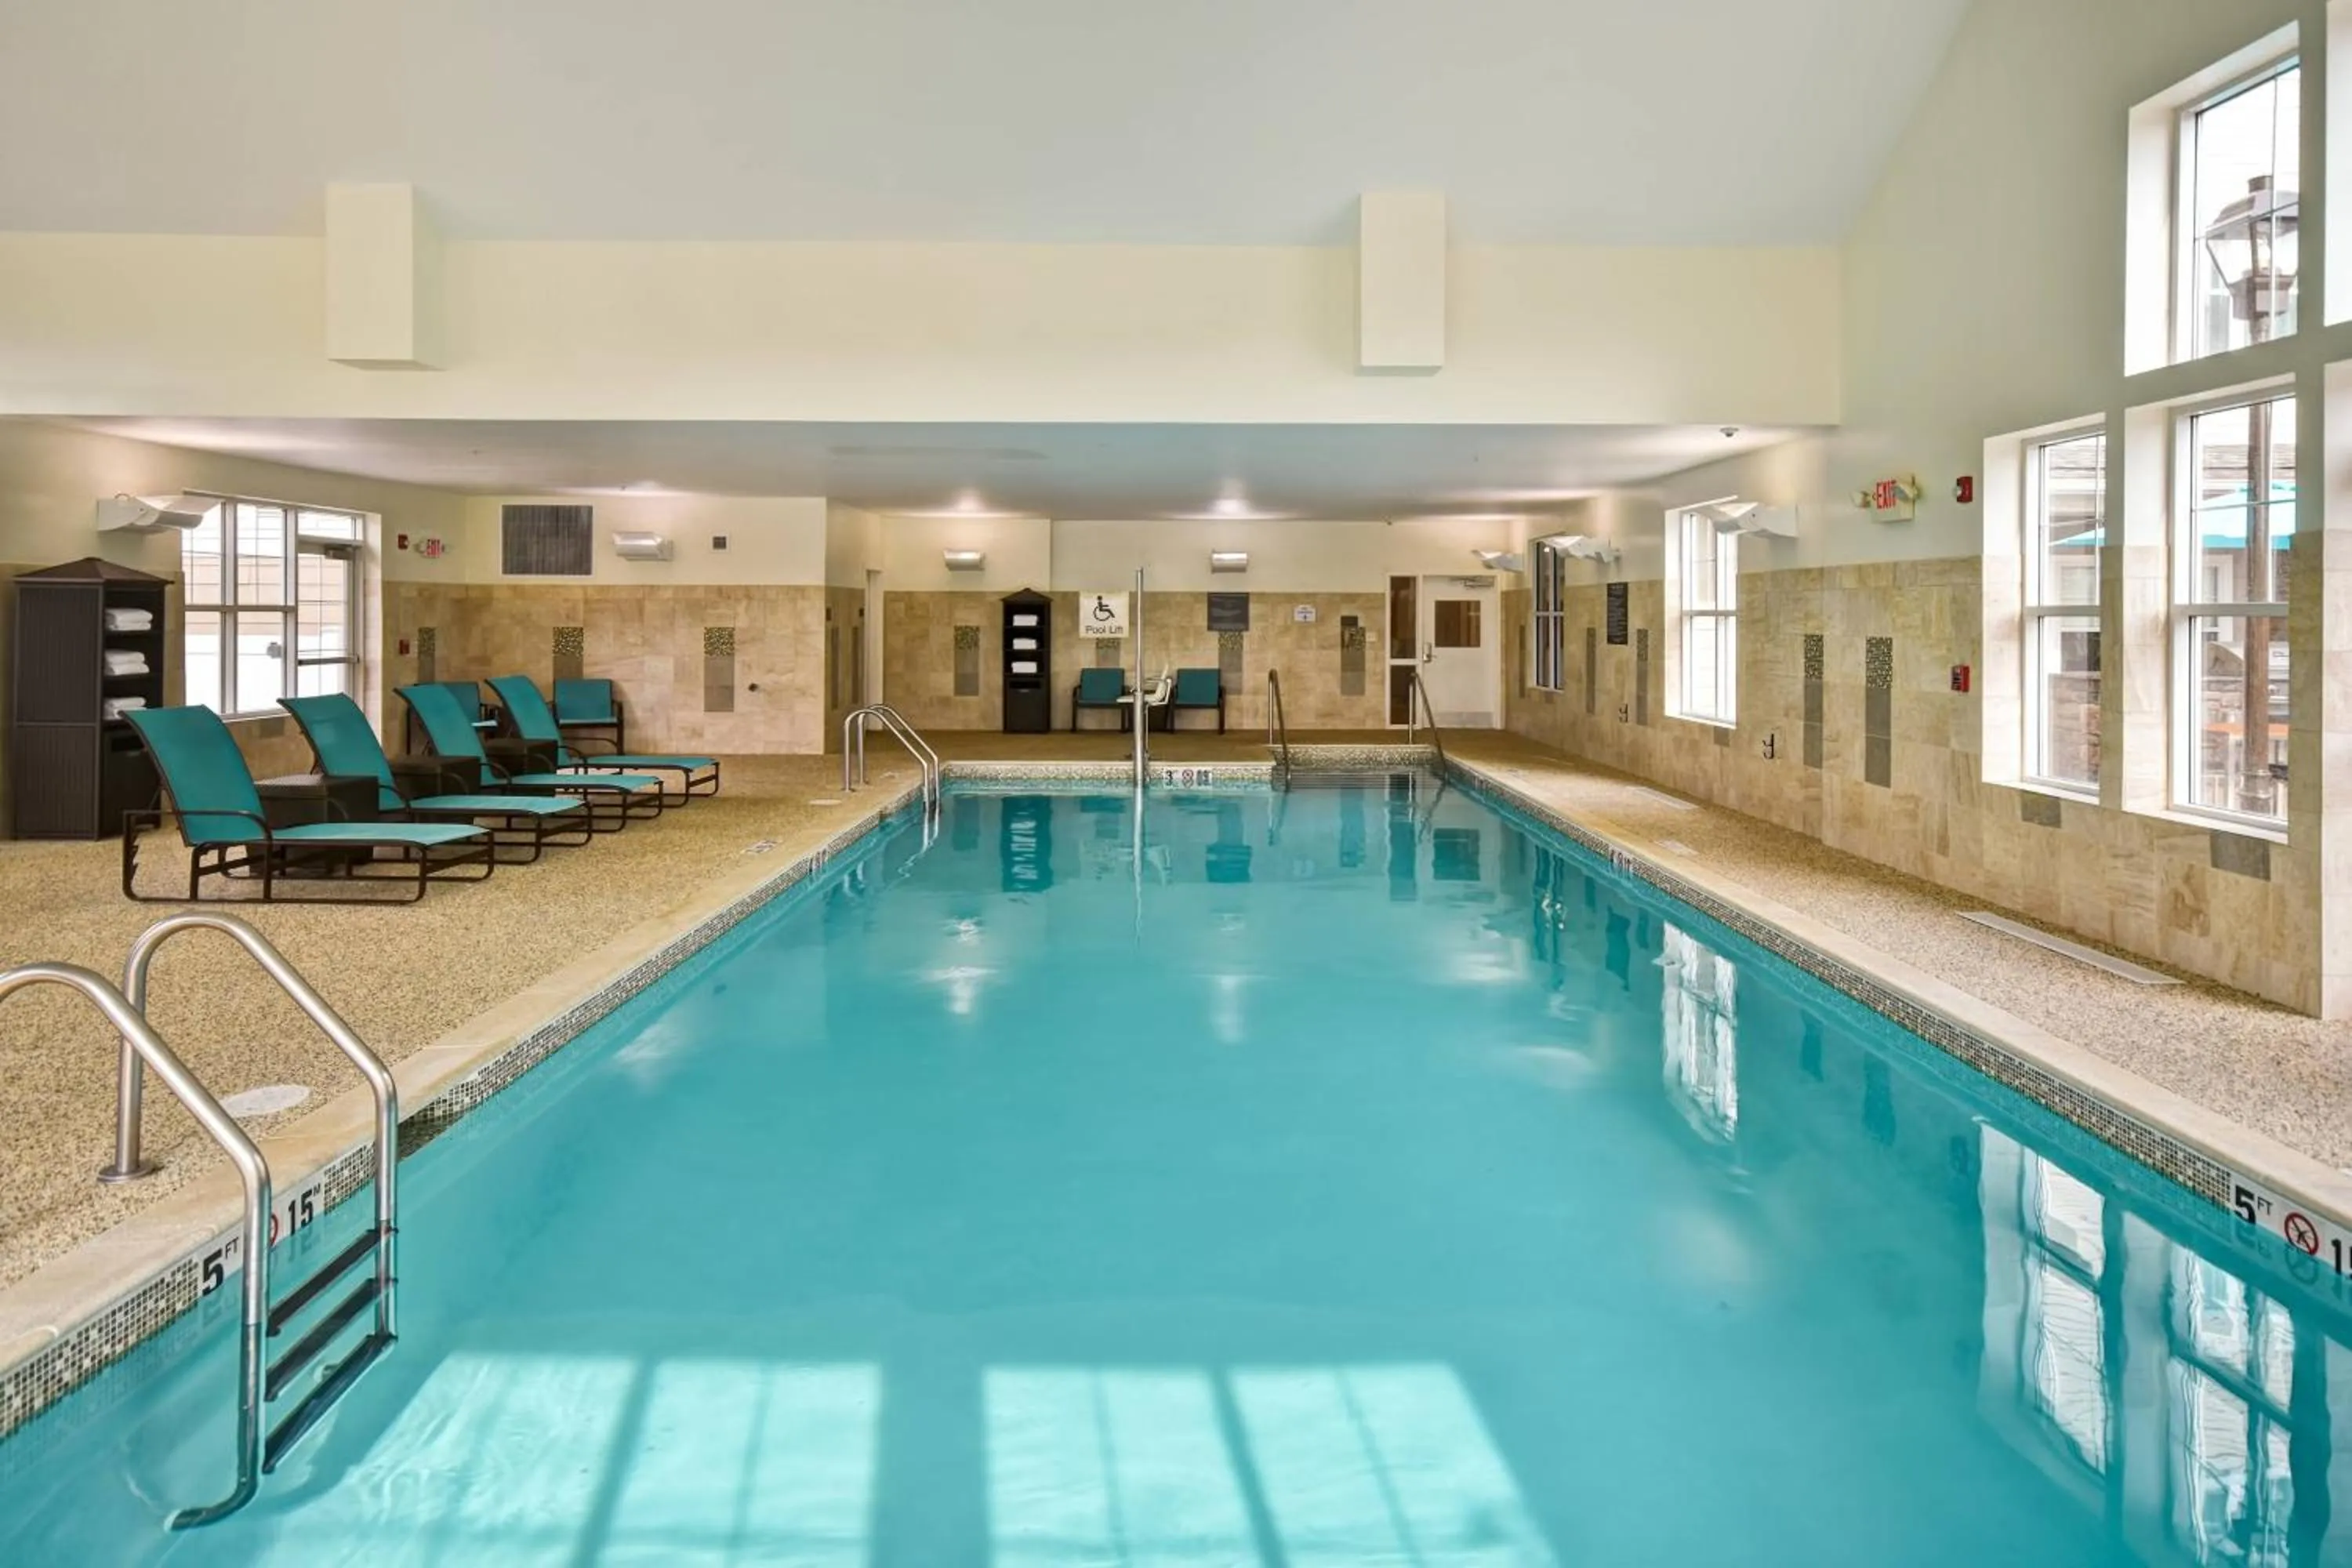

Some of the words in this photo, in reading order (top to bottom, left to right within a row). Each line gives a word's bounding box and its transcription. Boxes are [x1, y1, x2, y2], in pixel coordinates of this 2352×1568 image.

[1876, 479, 1897, 510] EXIT
[1085, 625, 1106, 634] Pool
[2331, 1237, 2352, 1279] 1
